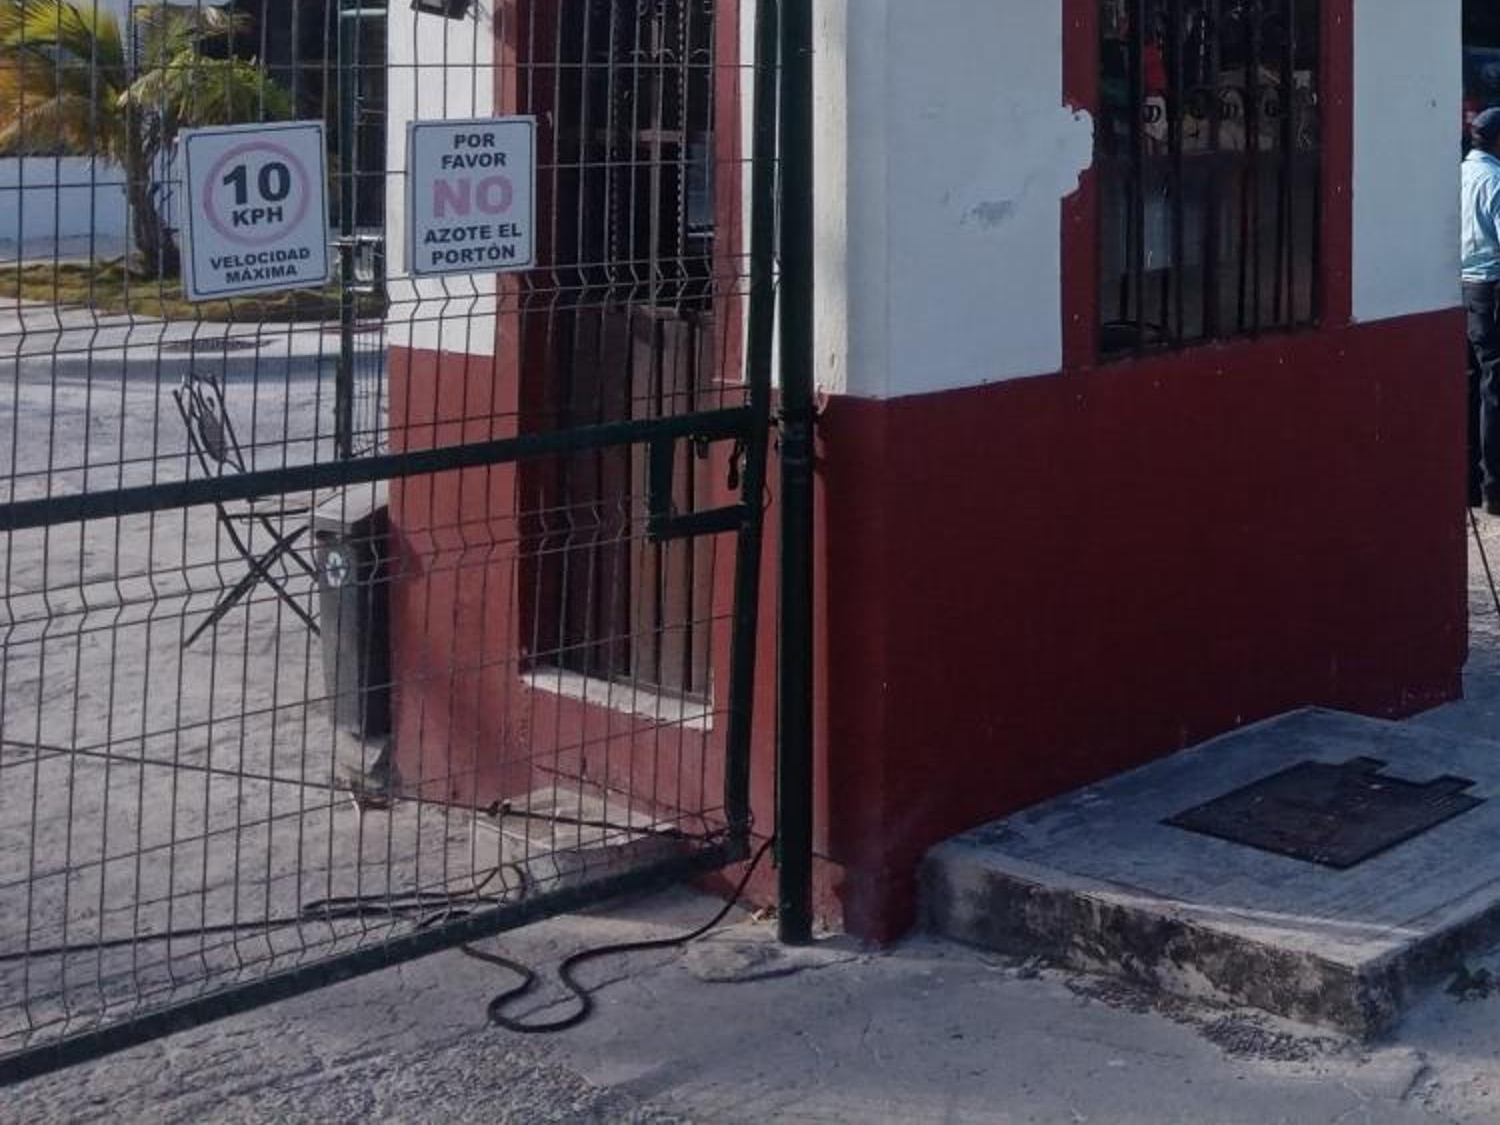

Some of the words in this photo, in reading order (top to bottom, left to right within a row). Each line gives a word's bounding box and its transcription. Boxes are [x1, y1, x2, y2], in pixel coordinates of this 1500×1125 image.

[453, 132, 496, 149] POR
[441, 151, 508, 170] FAVOR
[223, 162, 291, 206] 10
[432, 175, 513, 219] NO
[231, 205, 284, 228] KPH
[423, 224, 493, 244] AZOTE
[498, 222, 522, 239] EL
[210, 246, 311, 271] VELOCIDAD
[430, 241, 516, 266] PORTÓN
